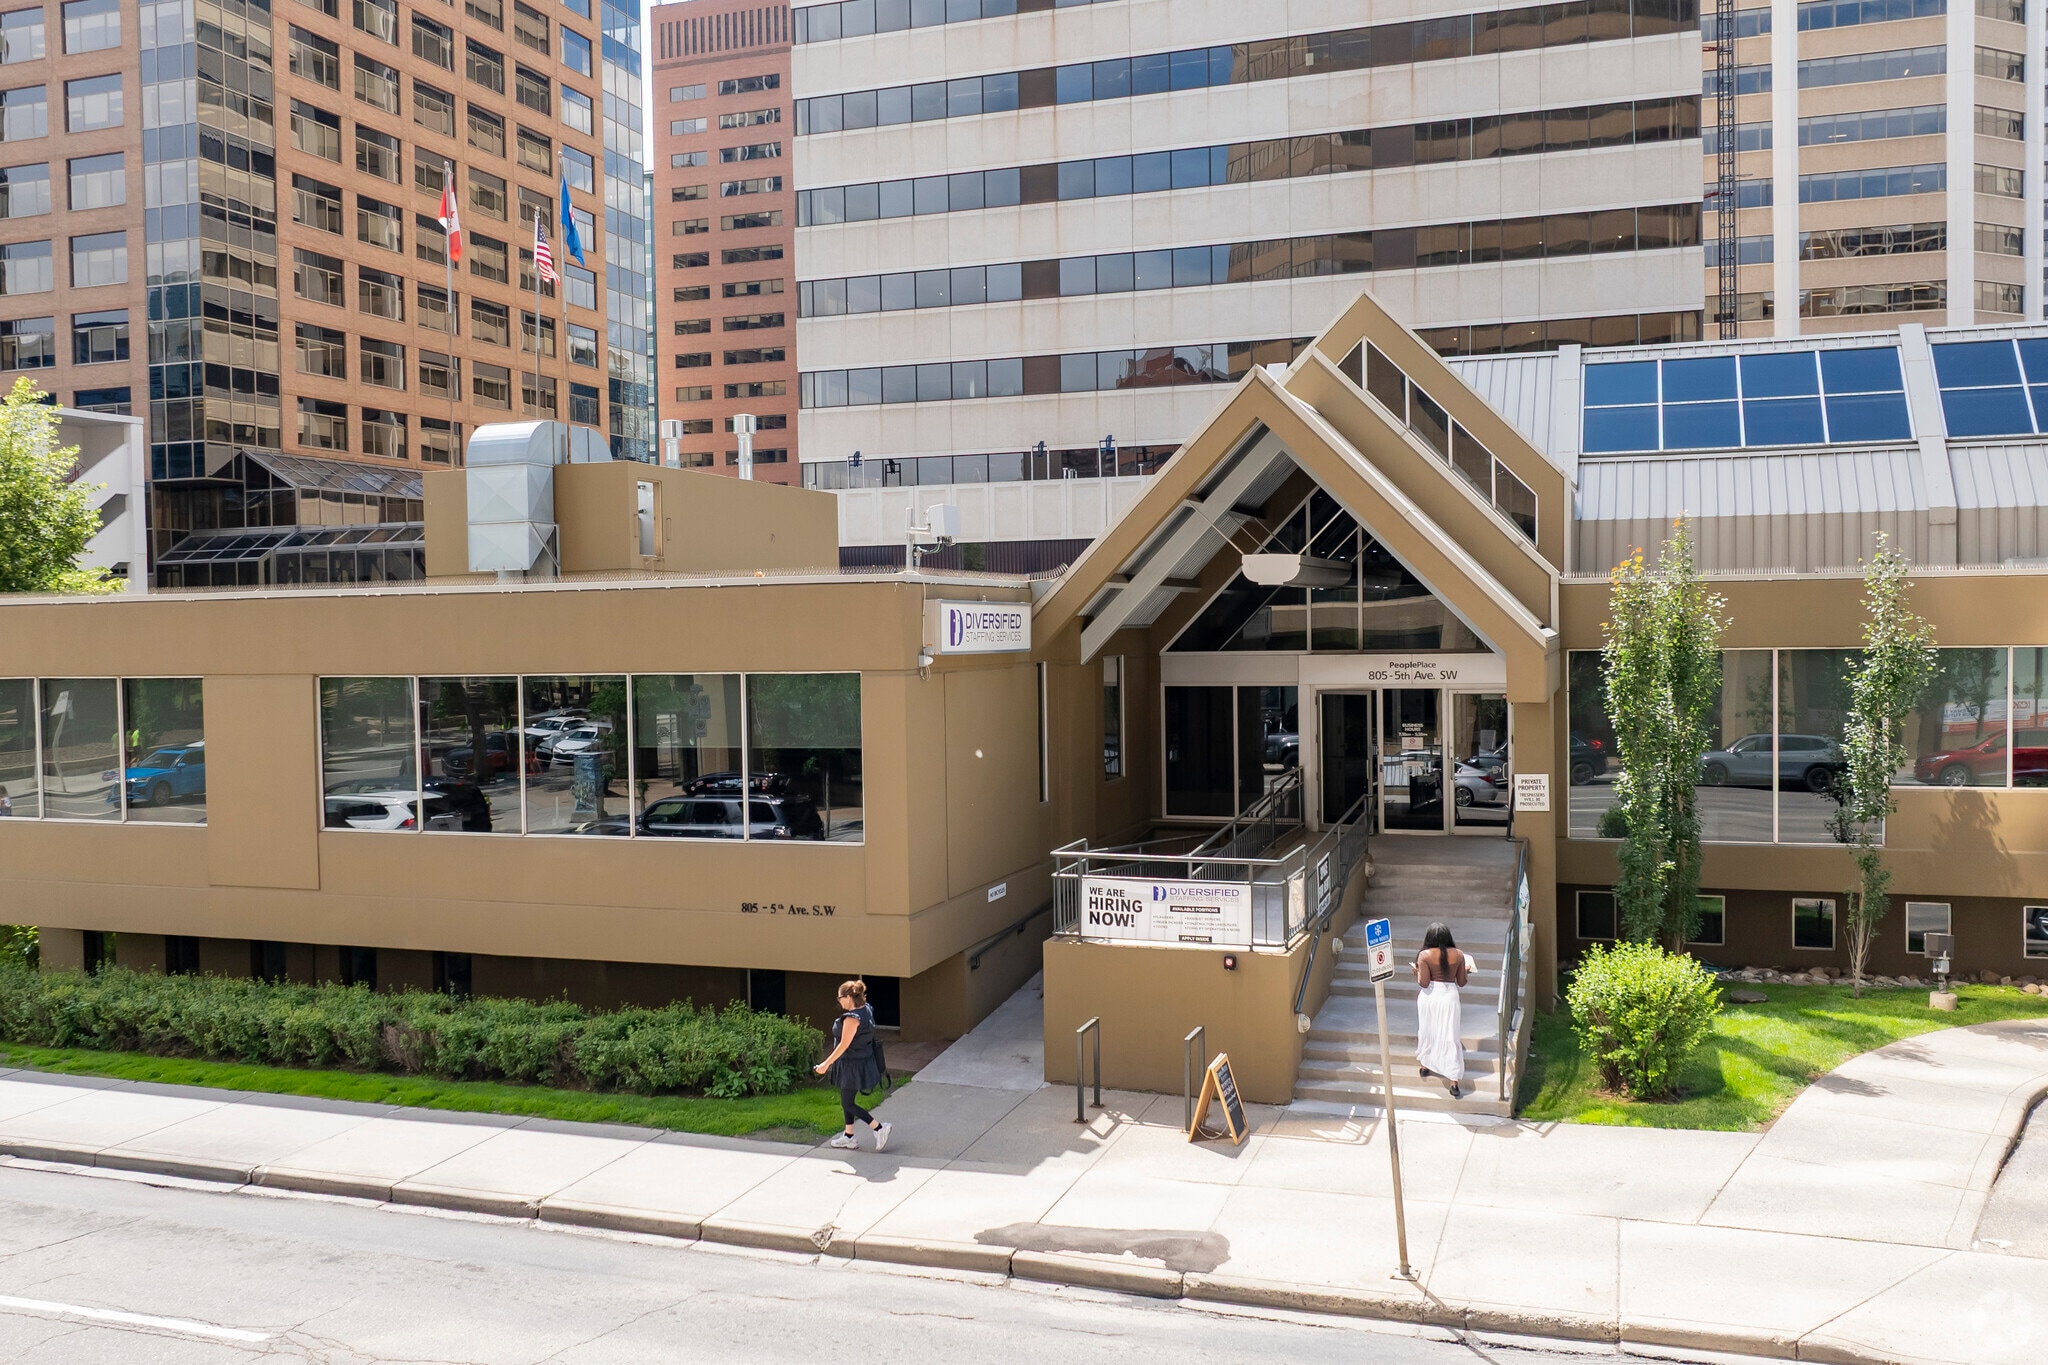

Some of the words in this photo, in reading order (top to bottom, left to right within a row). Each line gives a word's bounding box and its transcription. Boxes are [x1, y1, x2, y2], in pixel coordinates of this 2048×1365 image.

[966, 612, 1022, 630] DIVERSIFIED
[966, 632, 994, 642] STAFFING
[996, 630, 1022, 642] SERVICES
[1389, 662, 1436, 670] PeoplePlace
[1414, 671, 1436, 680] Ave.
[1440, 670, 1458, 680] SW
[1089, 886, 1103, 895] WE
[1106, 888, 1125, 897] ARE
[1170, 888, 1240, 897] DIVERSIFIED
[741, 903, 758, 913] 805
[770, 904, 784, 914] 5th
[788, 904, 809, 915] Ave.
[1089, 897, 1142, 913] HIRING
[1089, 911, 1135, 927] NOW!
